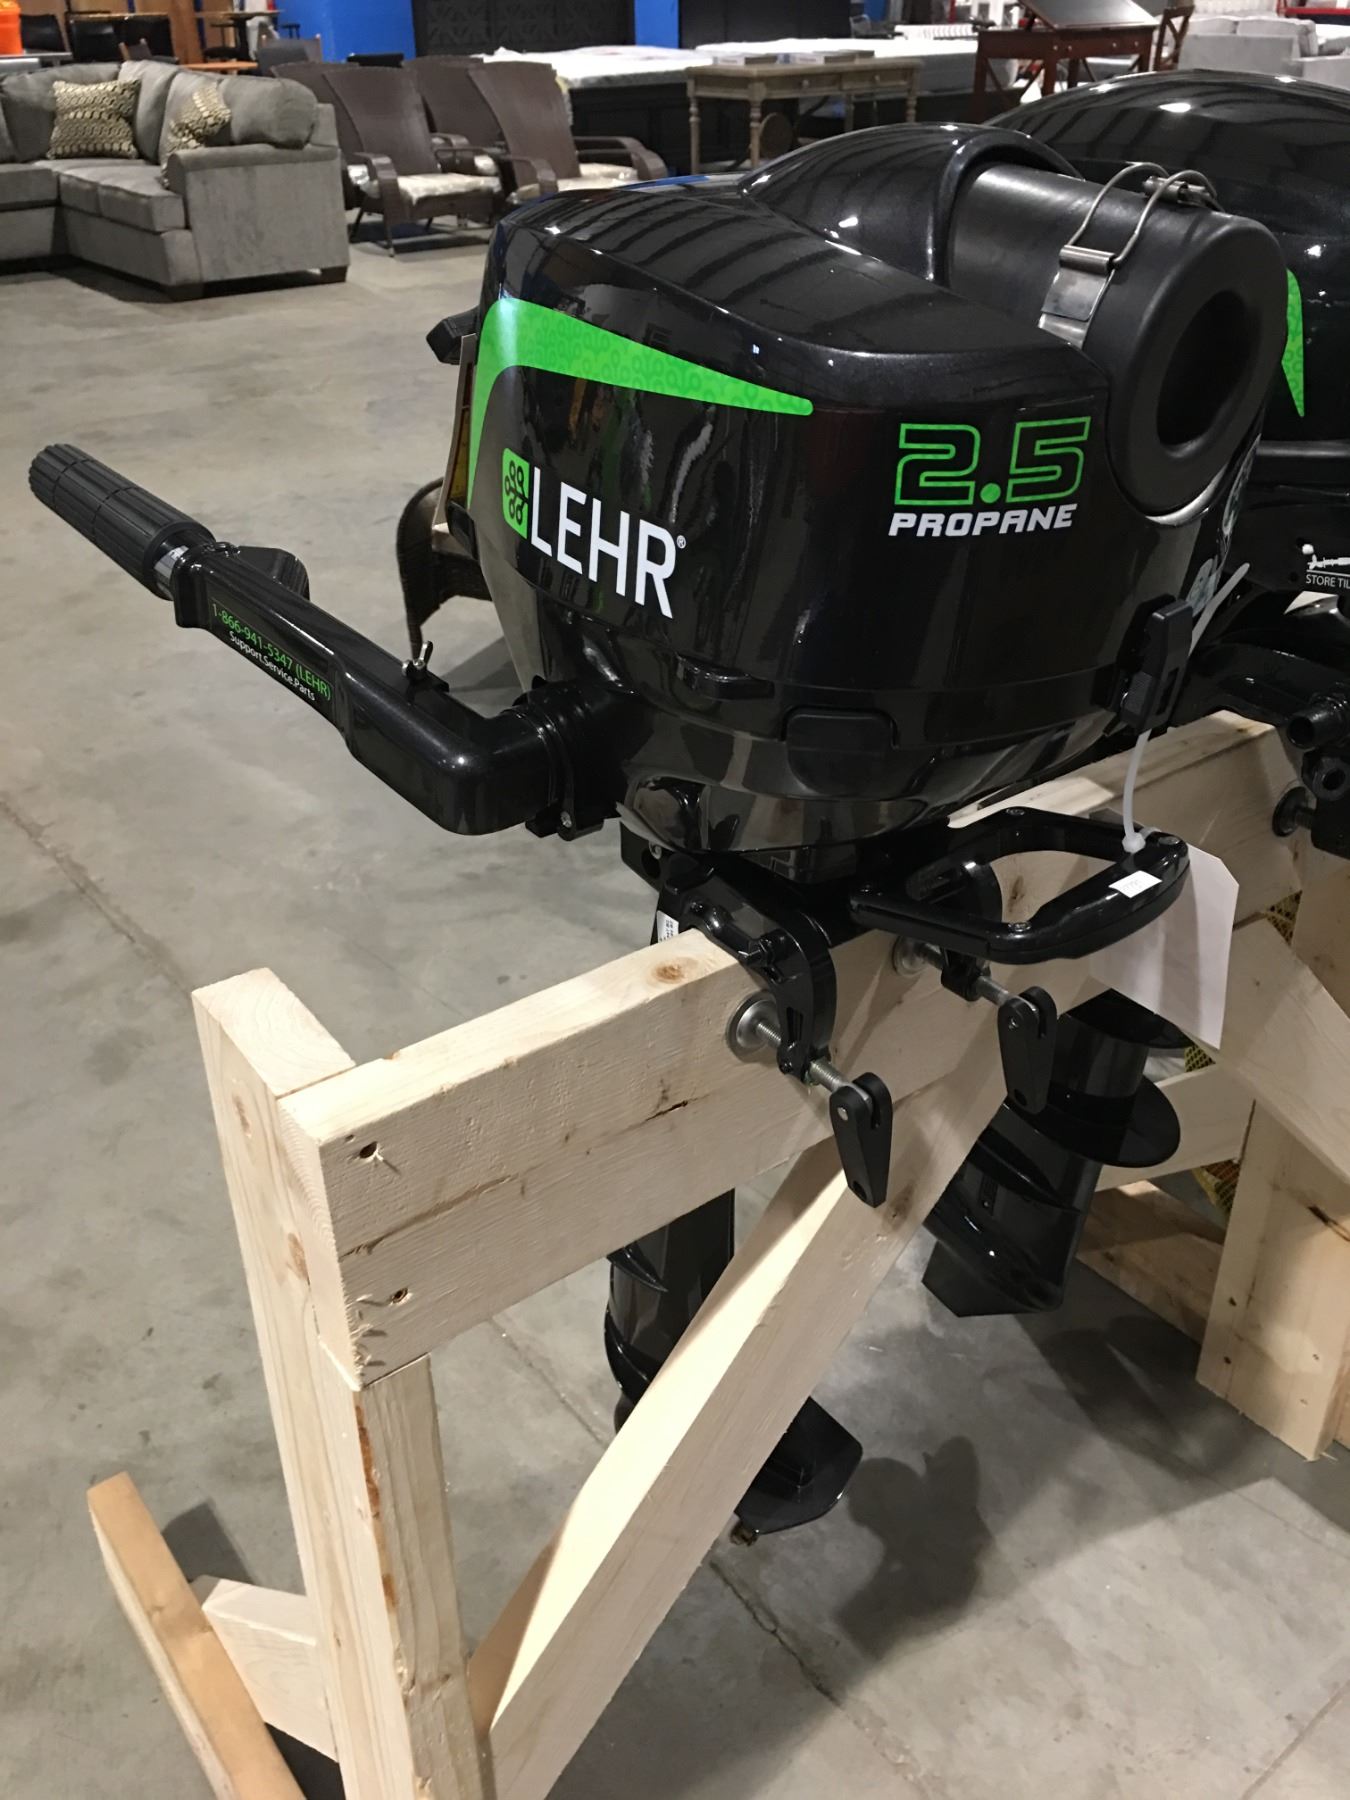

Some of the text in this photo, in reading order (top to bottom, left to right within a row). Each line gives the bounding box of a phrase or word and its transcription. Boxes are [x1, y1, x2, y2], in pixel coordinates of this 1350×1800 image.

[894, 416, 1091, 505] 2.5
[888, 503, 1078, 537] PROPANE
[1305, 574, 1336, 588] STORE
[212, 603, 332, 701] 1-866-941-5347 (LEHR)
